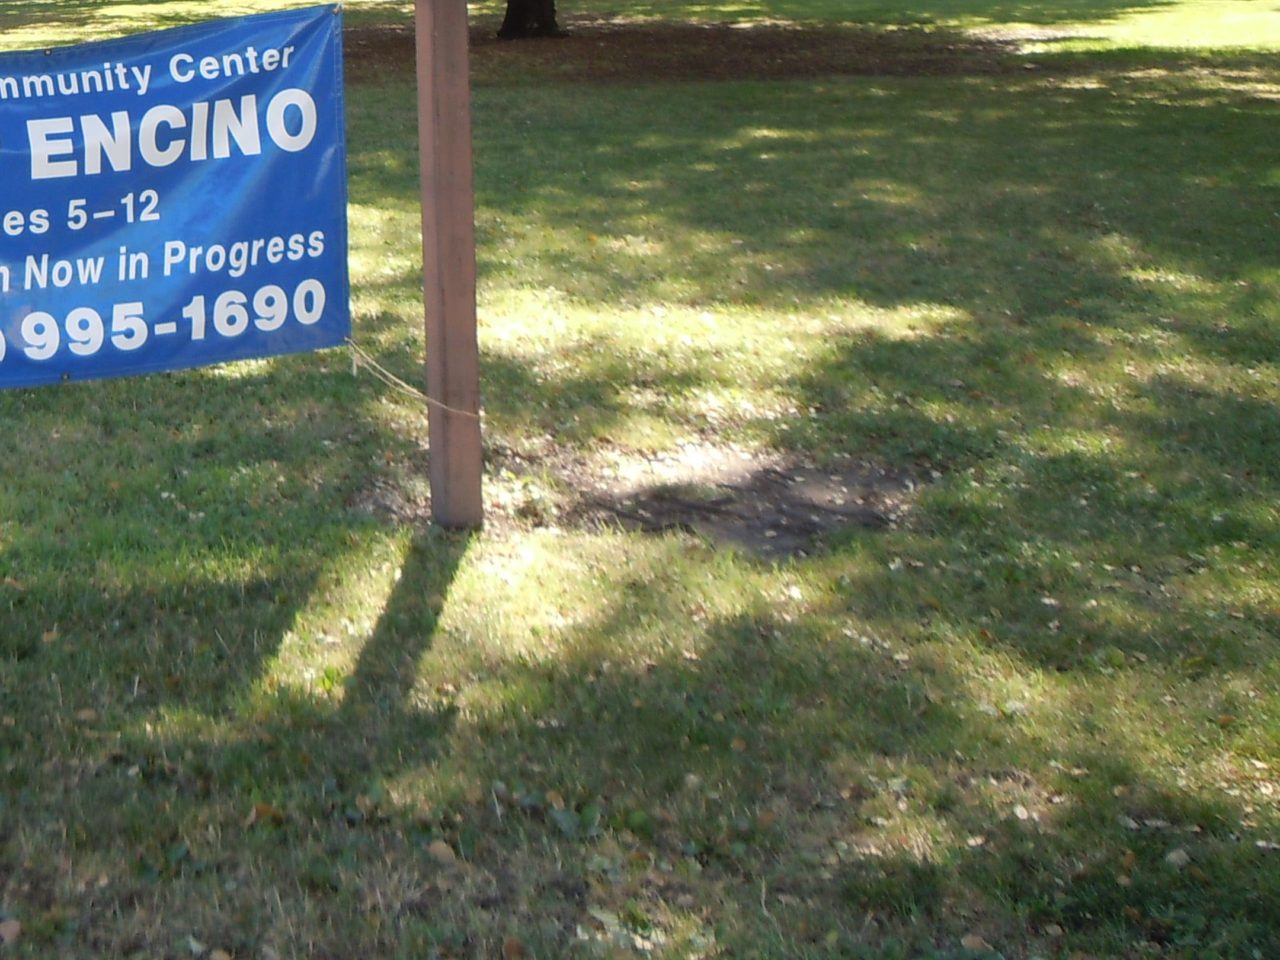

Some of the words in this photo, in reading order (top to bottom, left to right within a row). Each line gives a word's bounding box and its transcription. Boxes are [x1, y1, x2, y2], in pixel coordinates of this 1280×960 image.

[170, 44, 294, 83] Center
[28, 88, 316, 180] ENCINO
[68, 189, 160, 229] 5-12
[25, 254, 104, 288] Now
[119, 247, 150, 282] in
[163, 231, 324, 278] Progress
[21, 279, 326, 360] 995-1690
